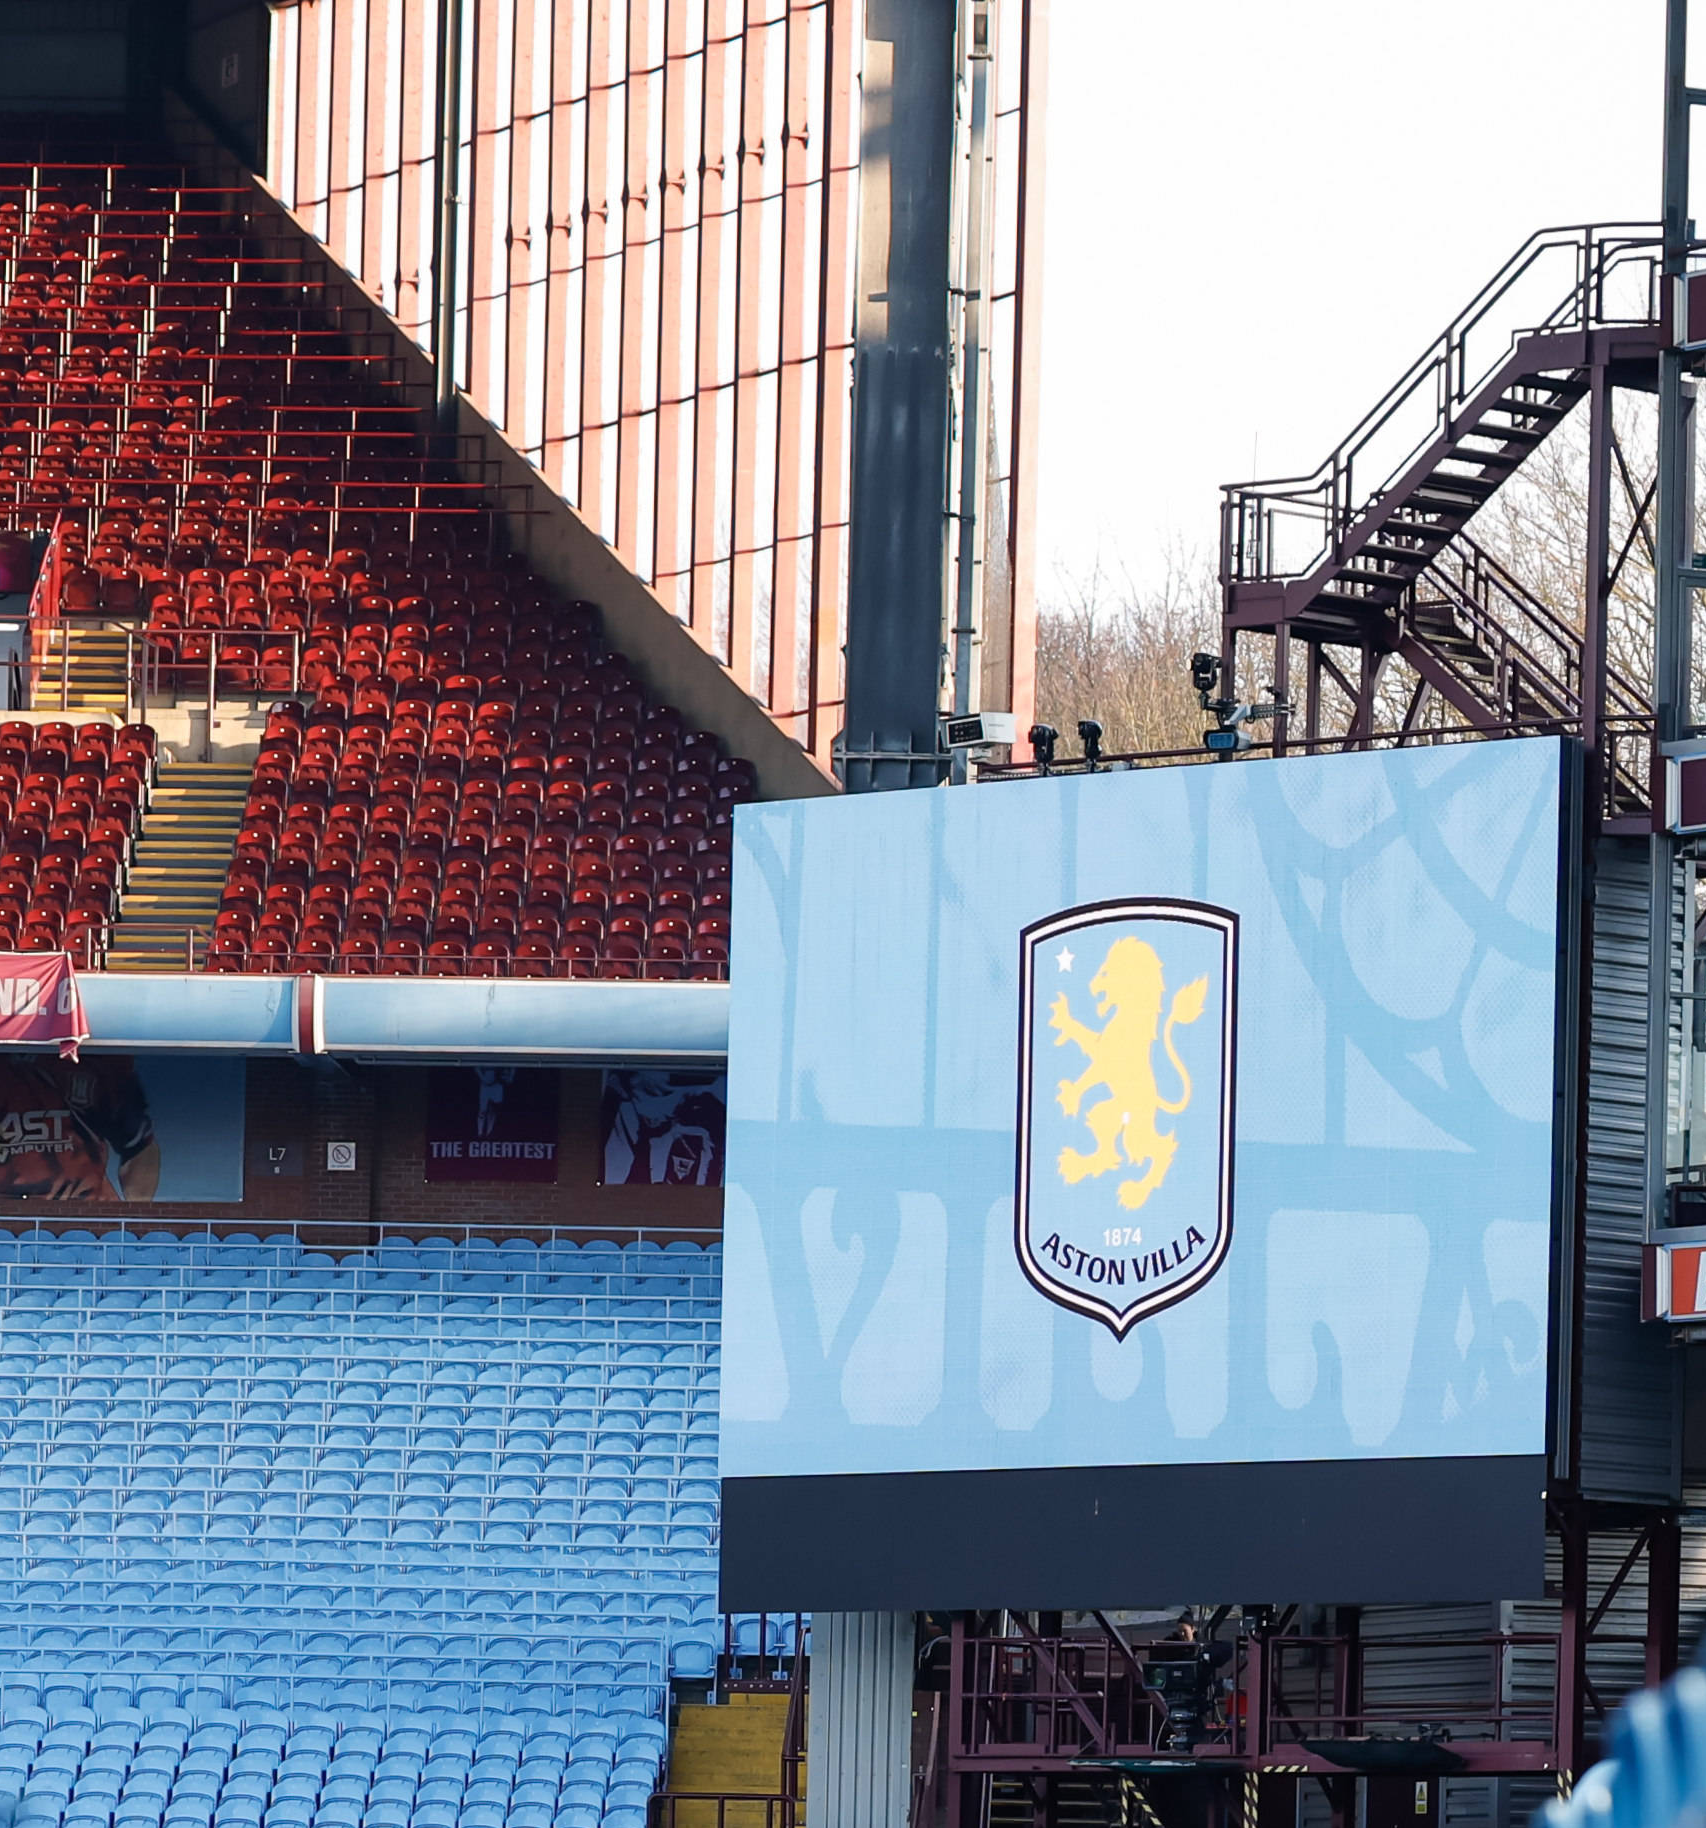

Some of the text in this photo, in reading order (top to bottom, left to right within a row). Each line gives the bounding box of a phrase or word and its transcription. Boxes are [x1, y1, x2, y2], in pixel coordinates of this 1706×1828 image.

[269, 1147, 287, 1161] L7
[430, 1141, 556, 1160] THE GREATEST
[1103, 1228, 1142, 1247] 1874
[1040, 1225, 1206, 1286] ASTON VILLA
